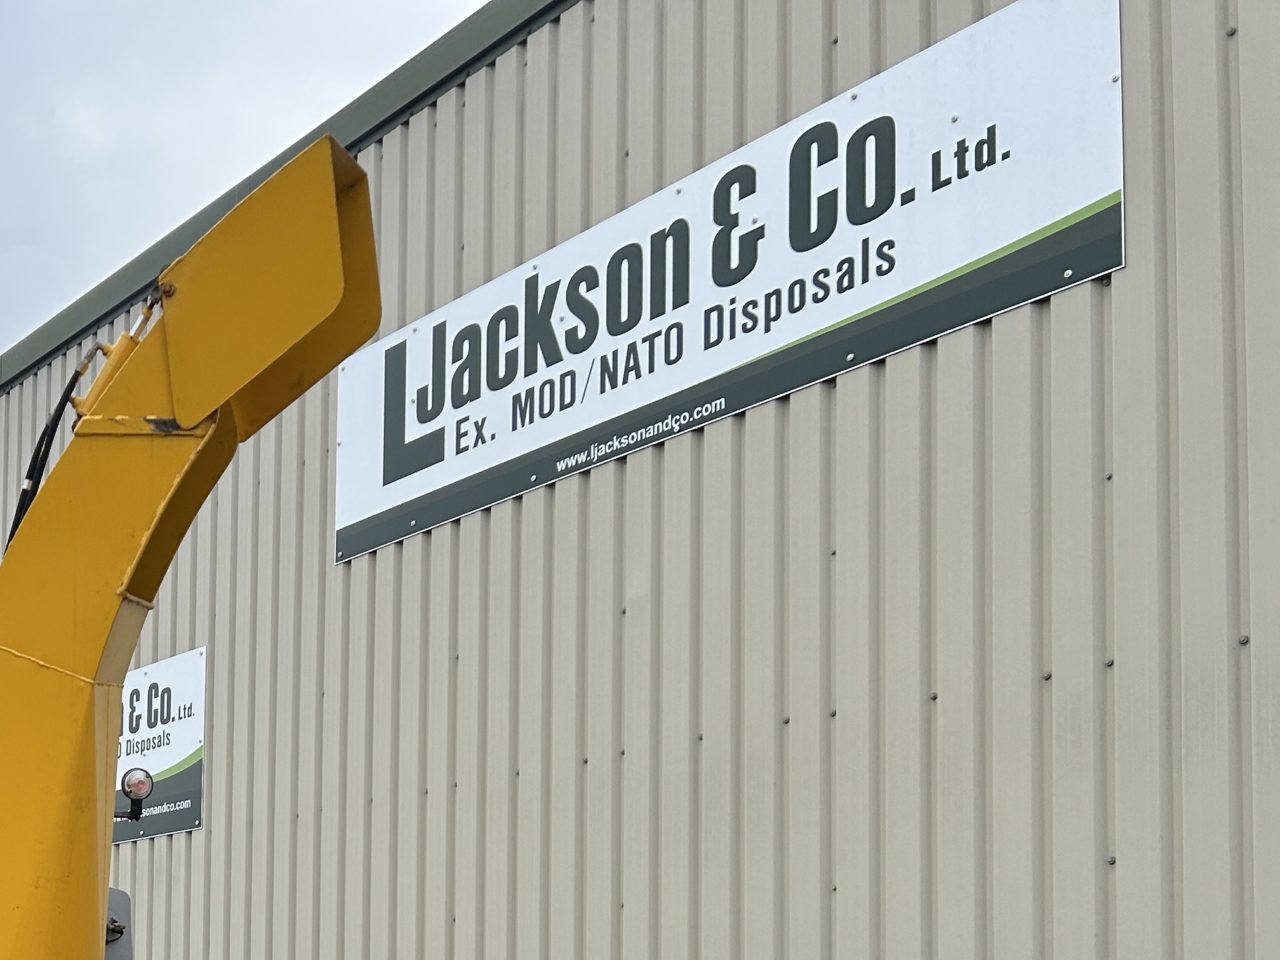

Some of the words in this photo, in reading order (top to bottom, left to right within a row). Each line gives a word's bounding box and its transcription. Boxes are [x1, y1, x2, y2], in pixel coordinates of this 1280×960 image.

[711, 164, 765, 287] &
[789, 115, 916, 253] Co.
[931, 124, 1011, 192] Ltd.
[455, 415, 496, 456] Ex.
[511, 321, 684, 432] MOD/NATO
[703, 237, 897, 350] Disposals
[556, 397, 726, 472] www.ljacksonandco.com
[126, 730, 171, 757] Disposals
[128, 688, 142, 733] &
[147, 682, 175, 729] Co.
[178, 702, 195, 721] Ltd.
